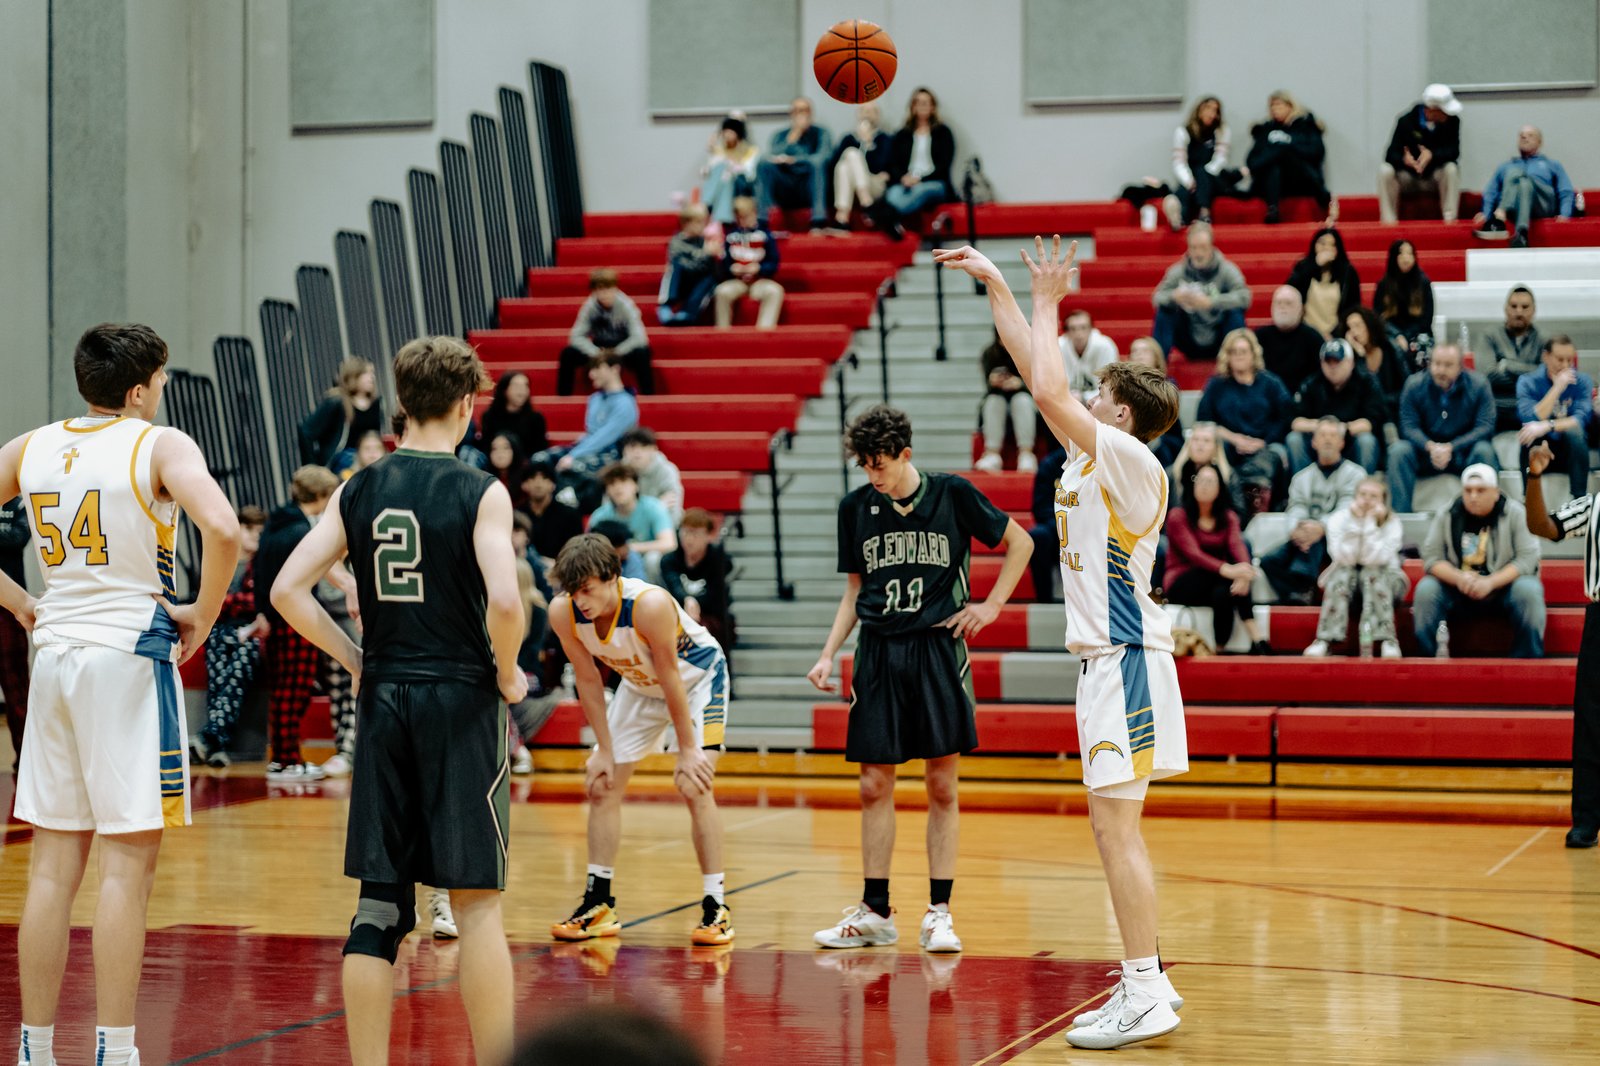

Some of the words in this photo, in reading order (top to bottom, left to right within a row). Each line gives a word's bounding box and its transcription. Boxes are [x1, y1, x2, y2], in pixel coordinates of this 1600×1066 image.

[29, 489, 109, 567] 54
[372, 508, 424, 602] 2
[882, 577, 923, 615] 11
